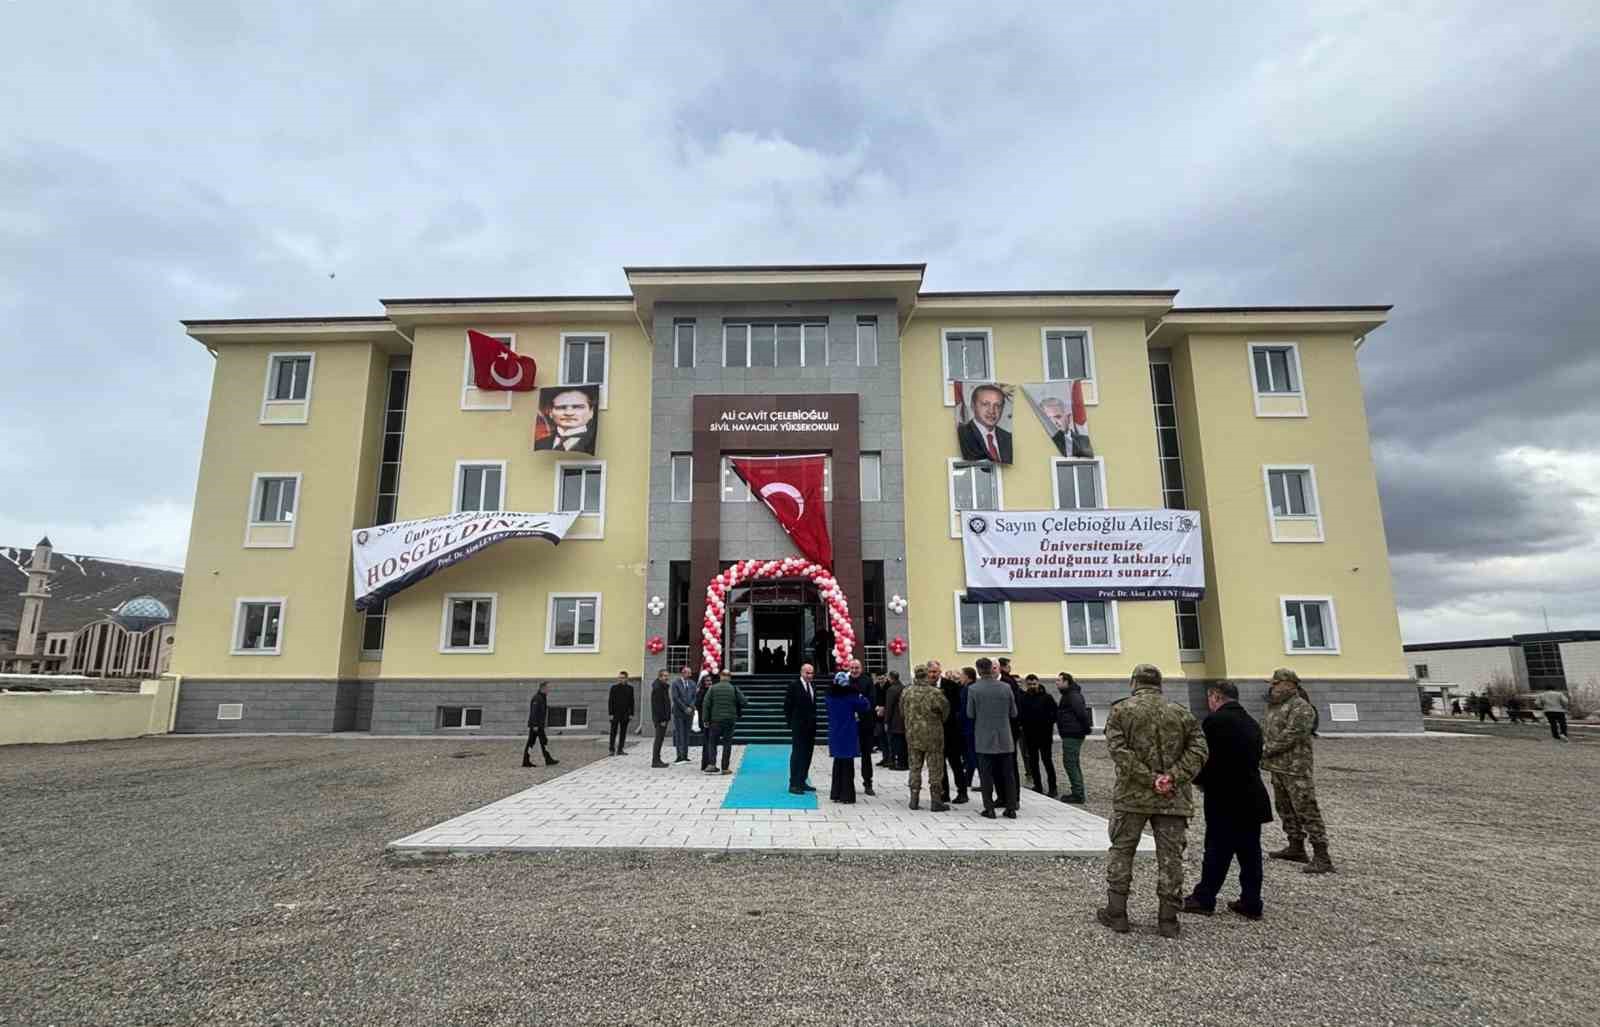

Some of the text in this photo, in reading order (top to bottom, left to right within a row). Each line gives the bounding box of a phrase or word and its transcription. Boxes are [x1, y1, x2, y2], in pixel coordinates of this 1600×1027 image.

[731, 423, 779, 431] HAVACILIK
[780, 422, 839, 431] YÜKSEKOKULU
[995, 516, 1173, 536] Sayın Çelebioğlu Ailesi
[1040, 538, 1143, 551] Üniversitemize
[981, 553, 1192, 568] yapmış olduğunuz katkılar için
[1008, 568, 1113, 581] şükranlarımızı
